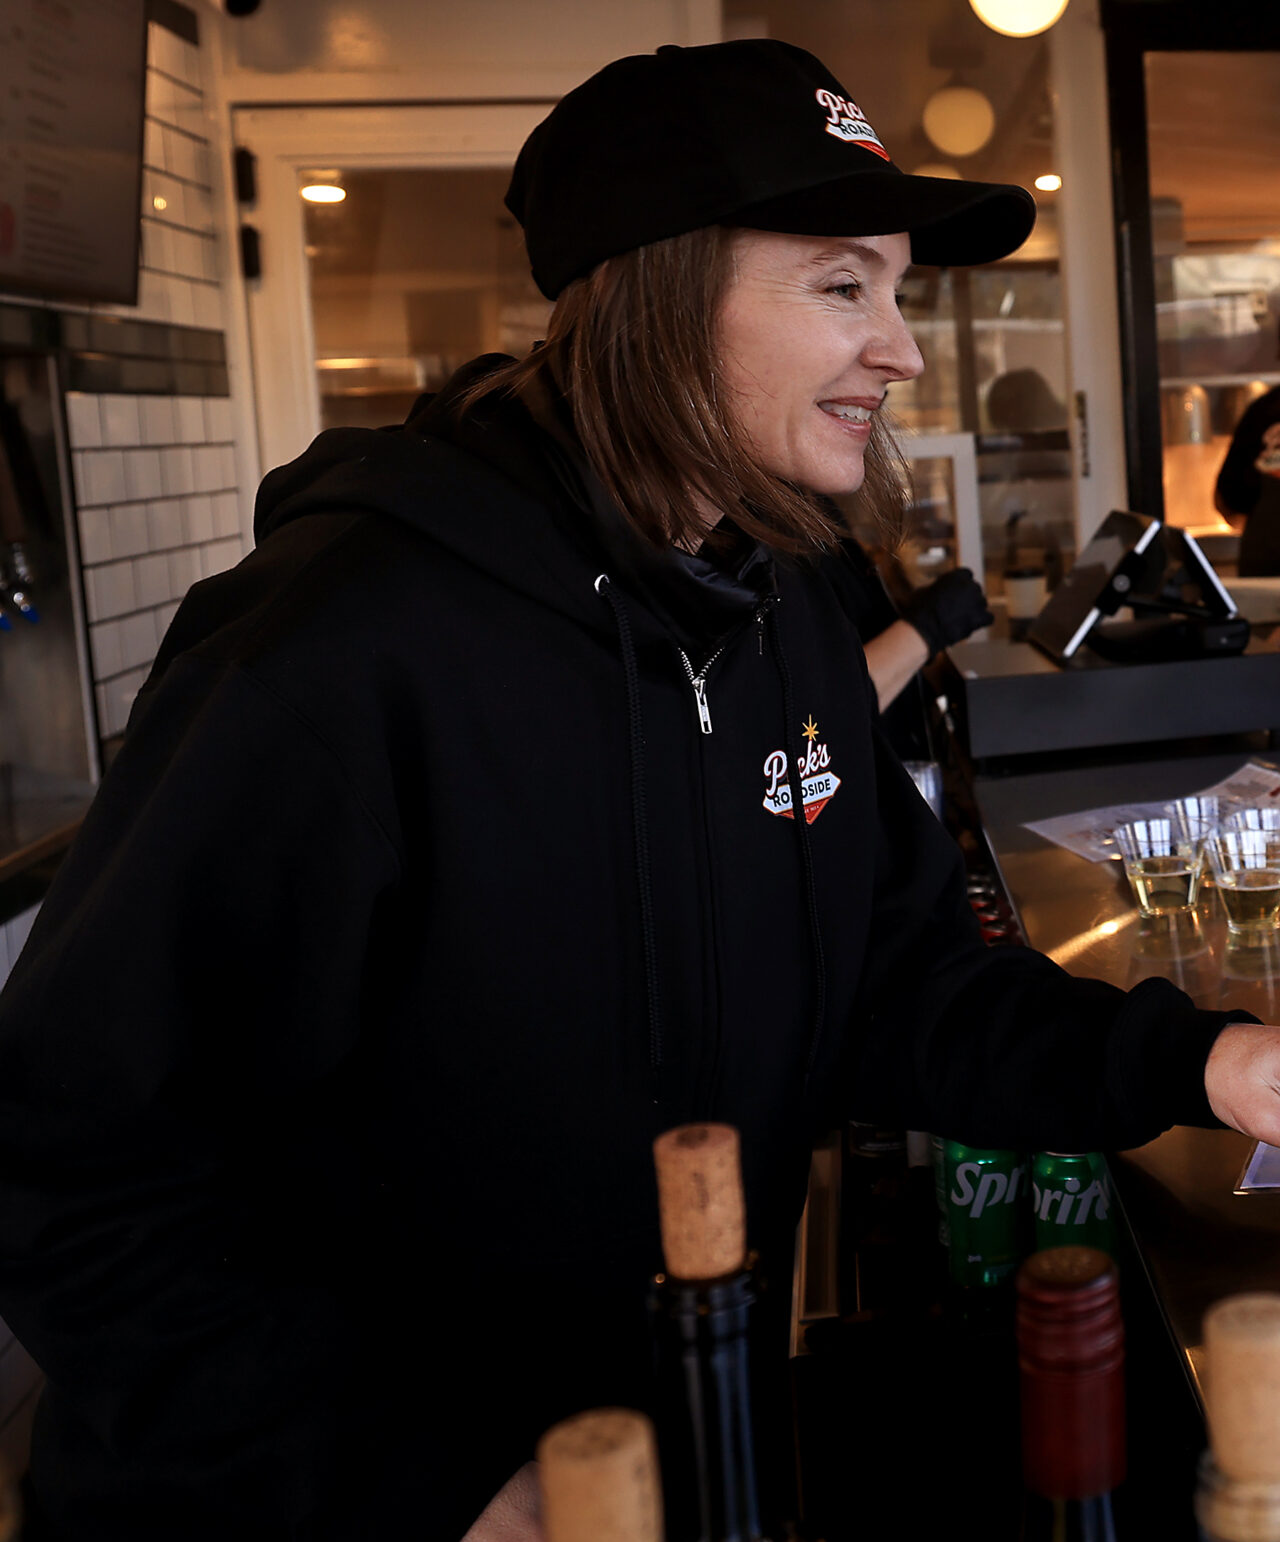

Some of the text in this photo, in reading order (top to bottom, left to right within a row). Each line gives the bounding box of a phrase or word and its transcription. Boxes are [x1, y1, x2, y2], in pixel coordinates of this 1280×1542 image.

[763, 739, 832, 797] Pck's
[773, 778, 831, 808] RODSIDE
[950, 1161, 1028, 1219] Spr
